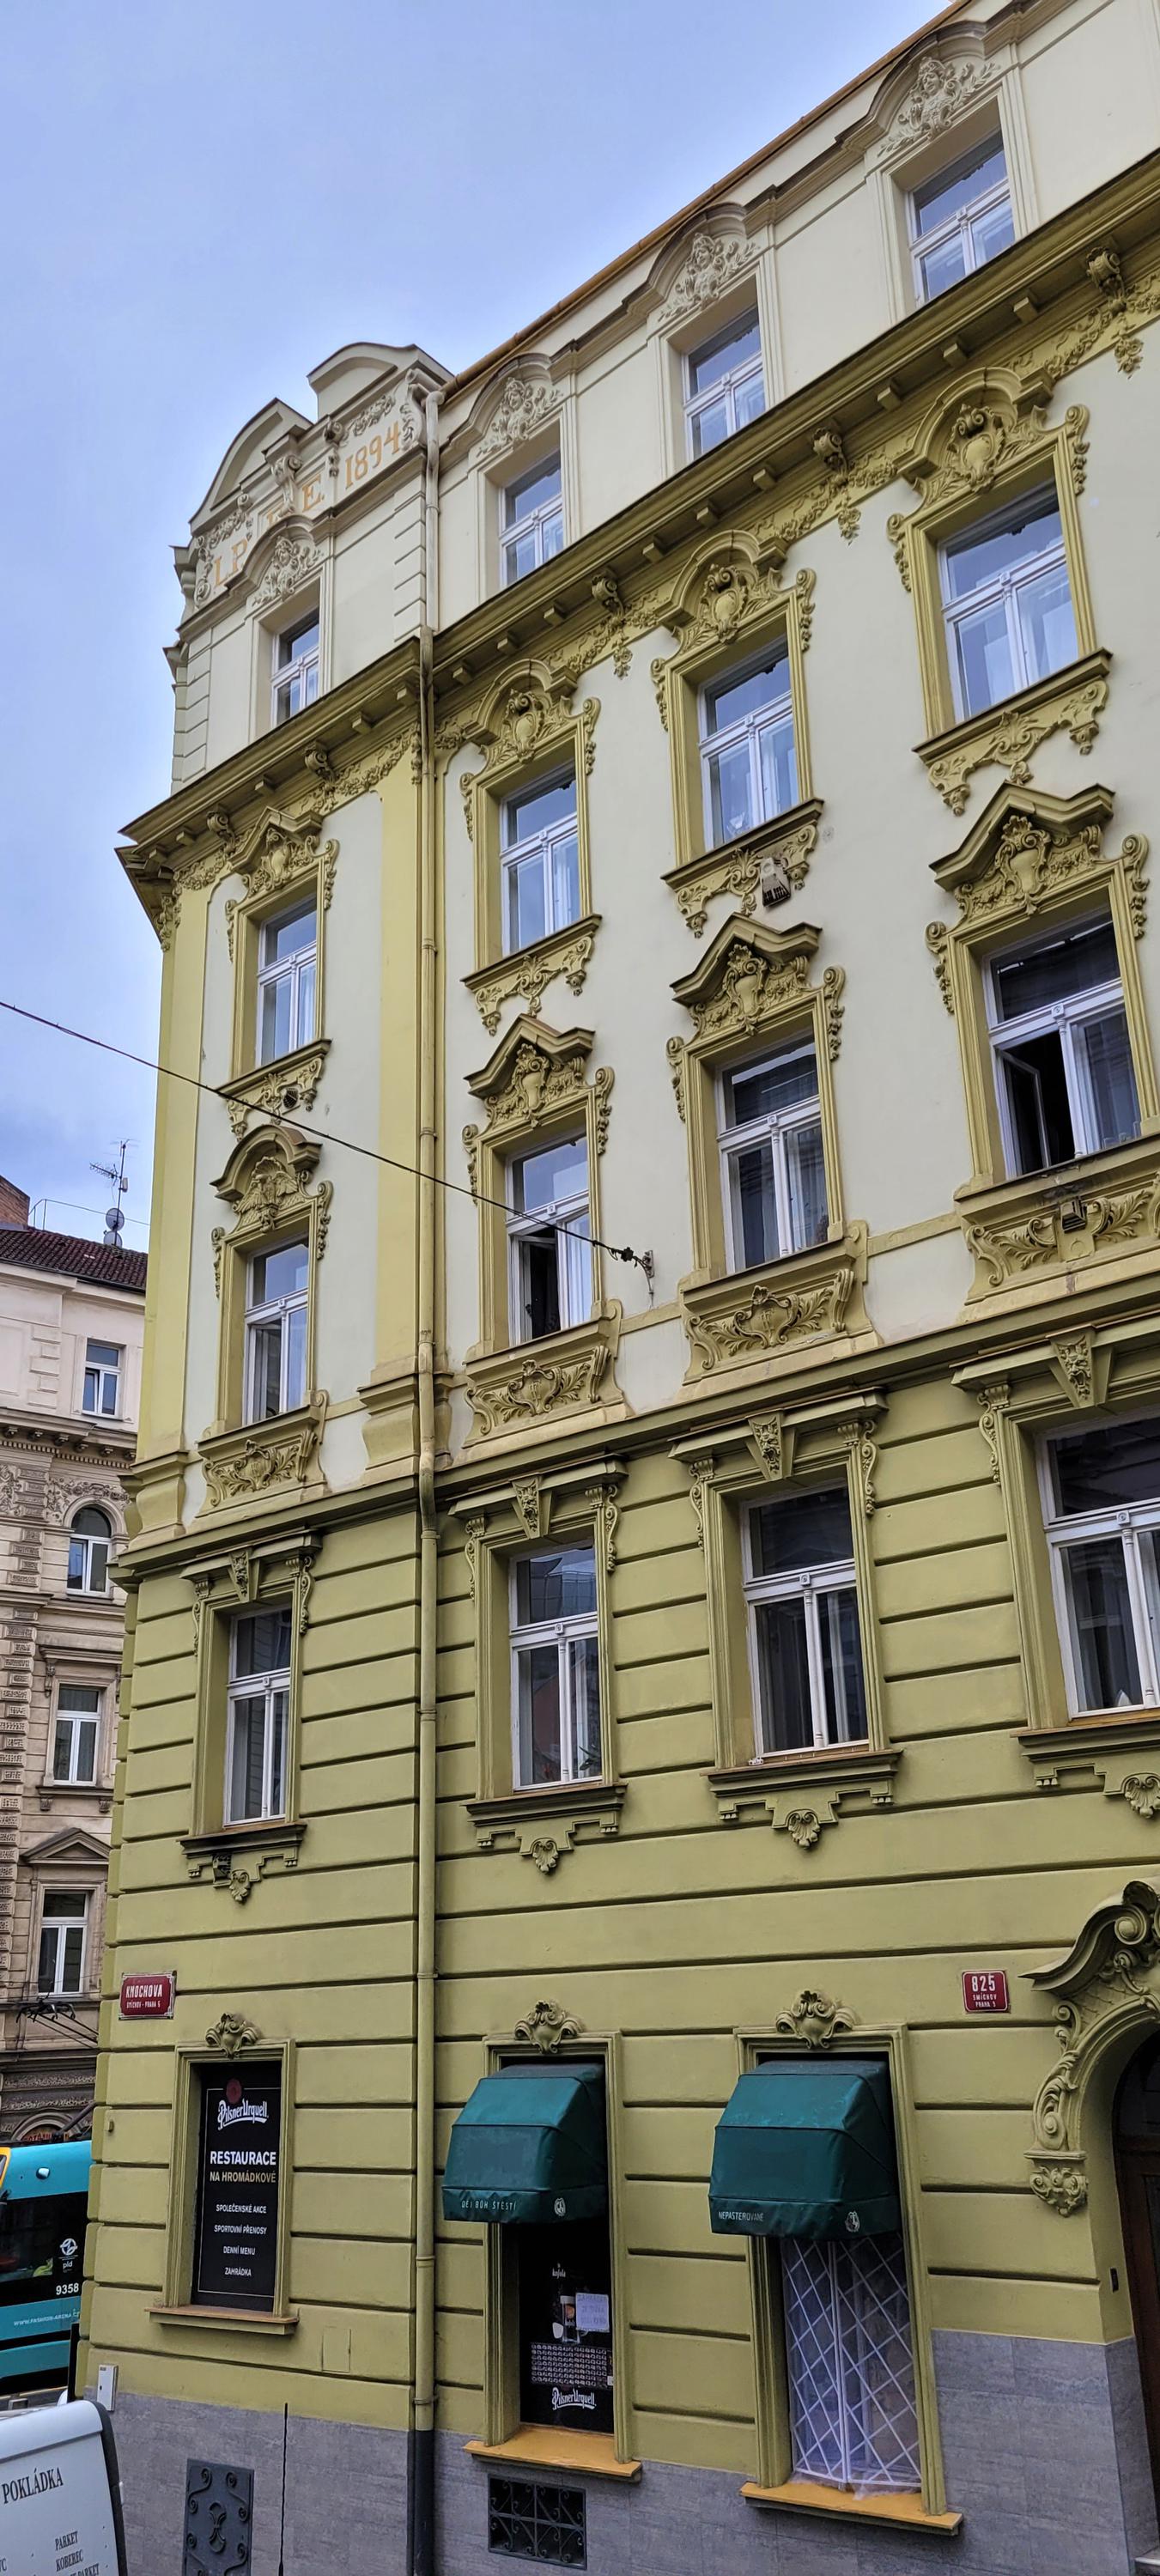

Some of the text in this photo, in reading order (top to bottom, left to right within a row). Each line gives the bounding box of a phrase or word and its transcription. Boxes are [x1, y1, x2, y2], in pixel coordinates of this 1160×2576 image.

[345, 421, 400, 489] 1894
[972, 1974, 996, 1992] 825
[126, 1984, 163, 1998] KMOCHOVA
[973, 1992, 997, 2001] SMÍCHOV
[217, 2098, 269, 2131] Pilsner Urquell
[210, 2150, 276, 2166] RESTAURACE
[210, 2169, 276, 2184] NA HROMÁDKOVÉ
[216, 2202, 267, 2214] SPOLEČENSKÉ AKCE
[214, 2224, 267, 2235] SPORTOVNÍ PŘENOSY
[223, 2245, 256, 2256] DENNÍ MENU
[224, 2267, 252, 2276] ZAHRÁDKA
[56, 2283, 79, 2295] 9358
[552, 2387, 596, 2410] Pilsner Urquell
[2, 2467, 64, 2504] POKLÁDKA
[55, 2530, 78, 2551] PARKET
[56, 2549, 84, 2572] KOBEREC
